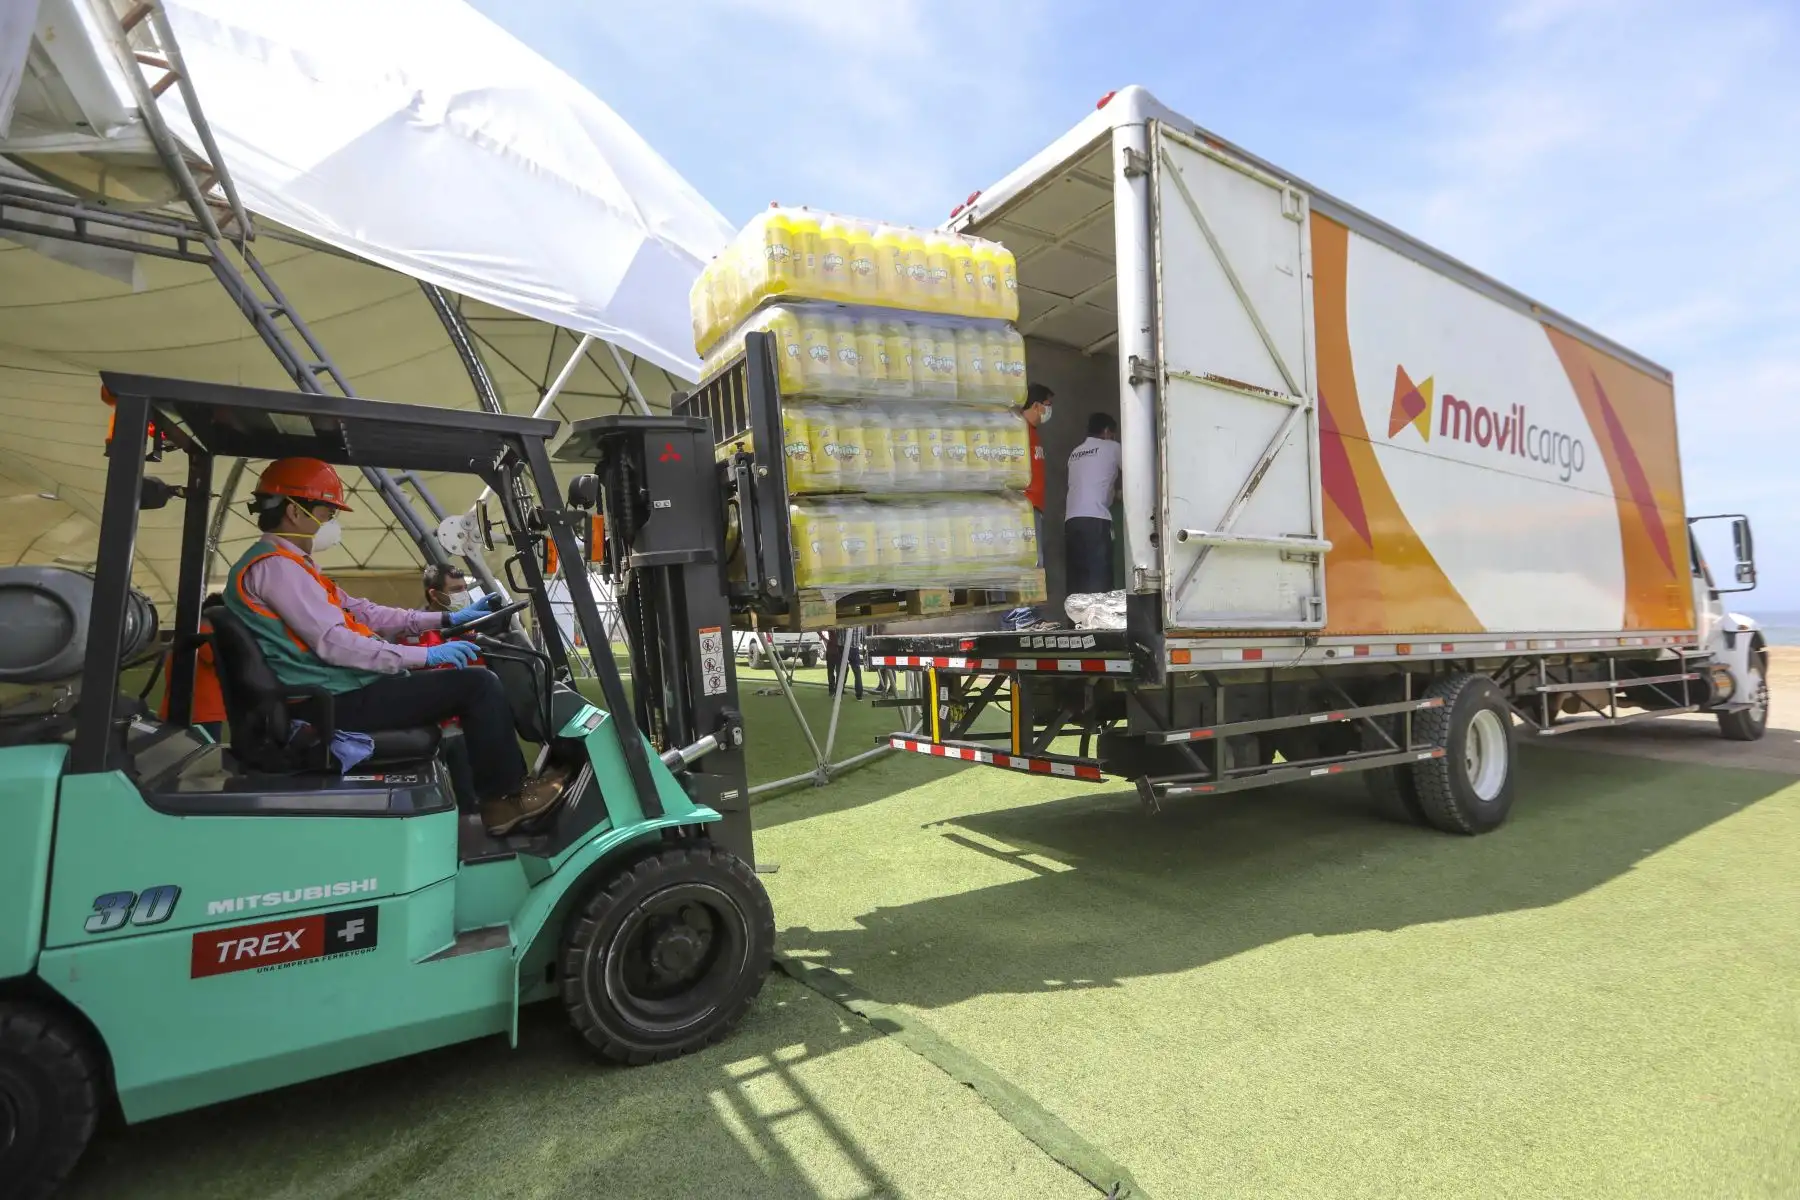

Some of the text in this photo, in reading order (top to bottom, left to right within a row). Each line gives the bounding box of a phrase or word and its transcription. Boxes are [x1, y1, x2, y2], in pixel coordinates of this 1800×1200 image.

[1439, 394, 1585, 482] movilcargo
[84, 885, 182, 934] 30
[207, 877, 378, 916] MITSUBISHI
[216, 927, 307, 964] TREX
[256, 965, 275, 974] UNA
[277, 957, 321, 970] EMPRESA
